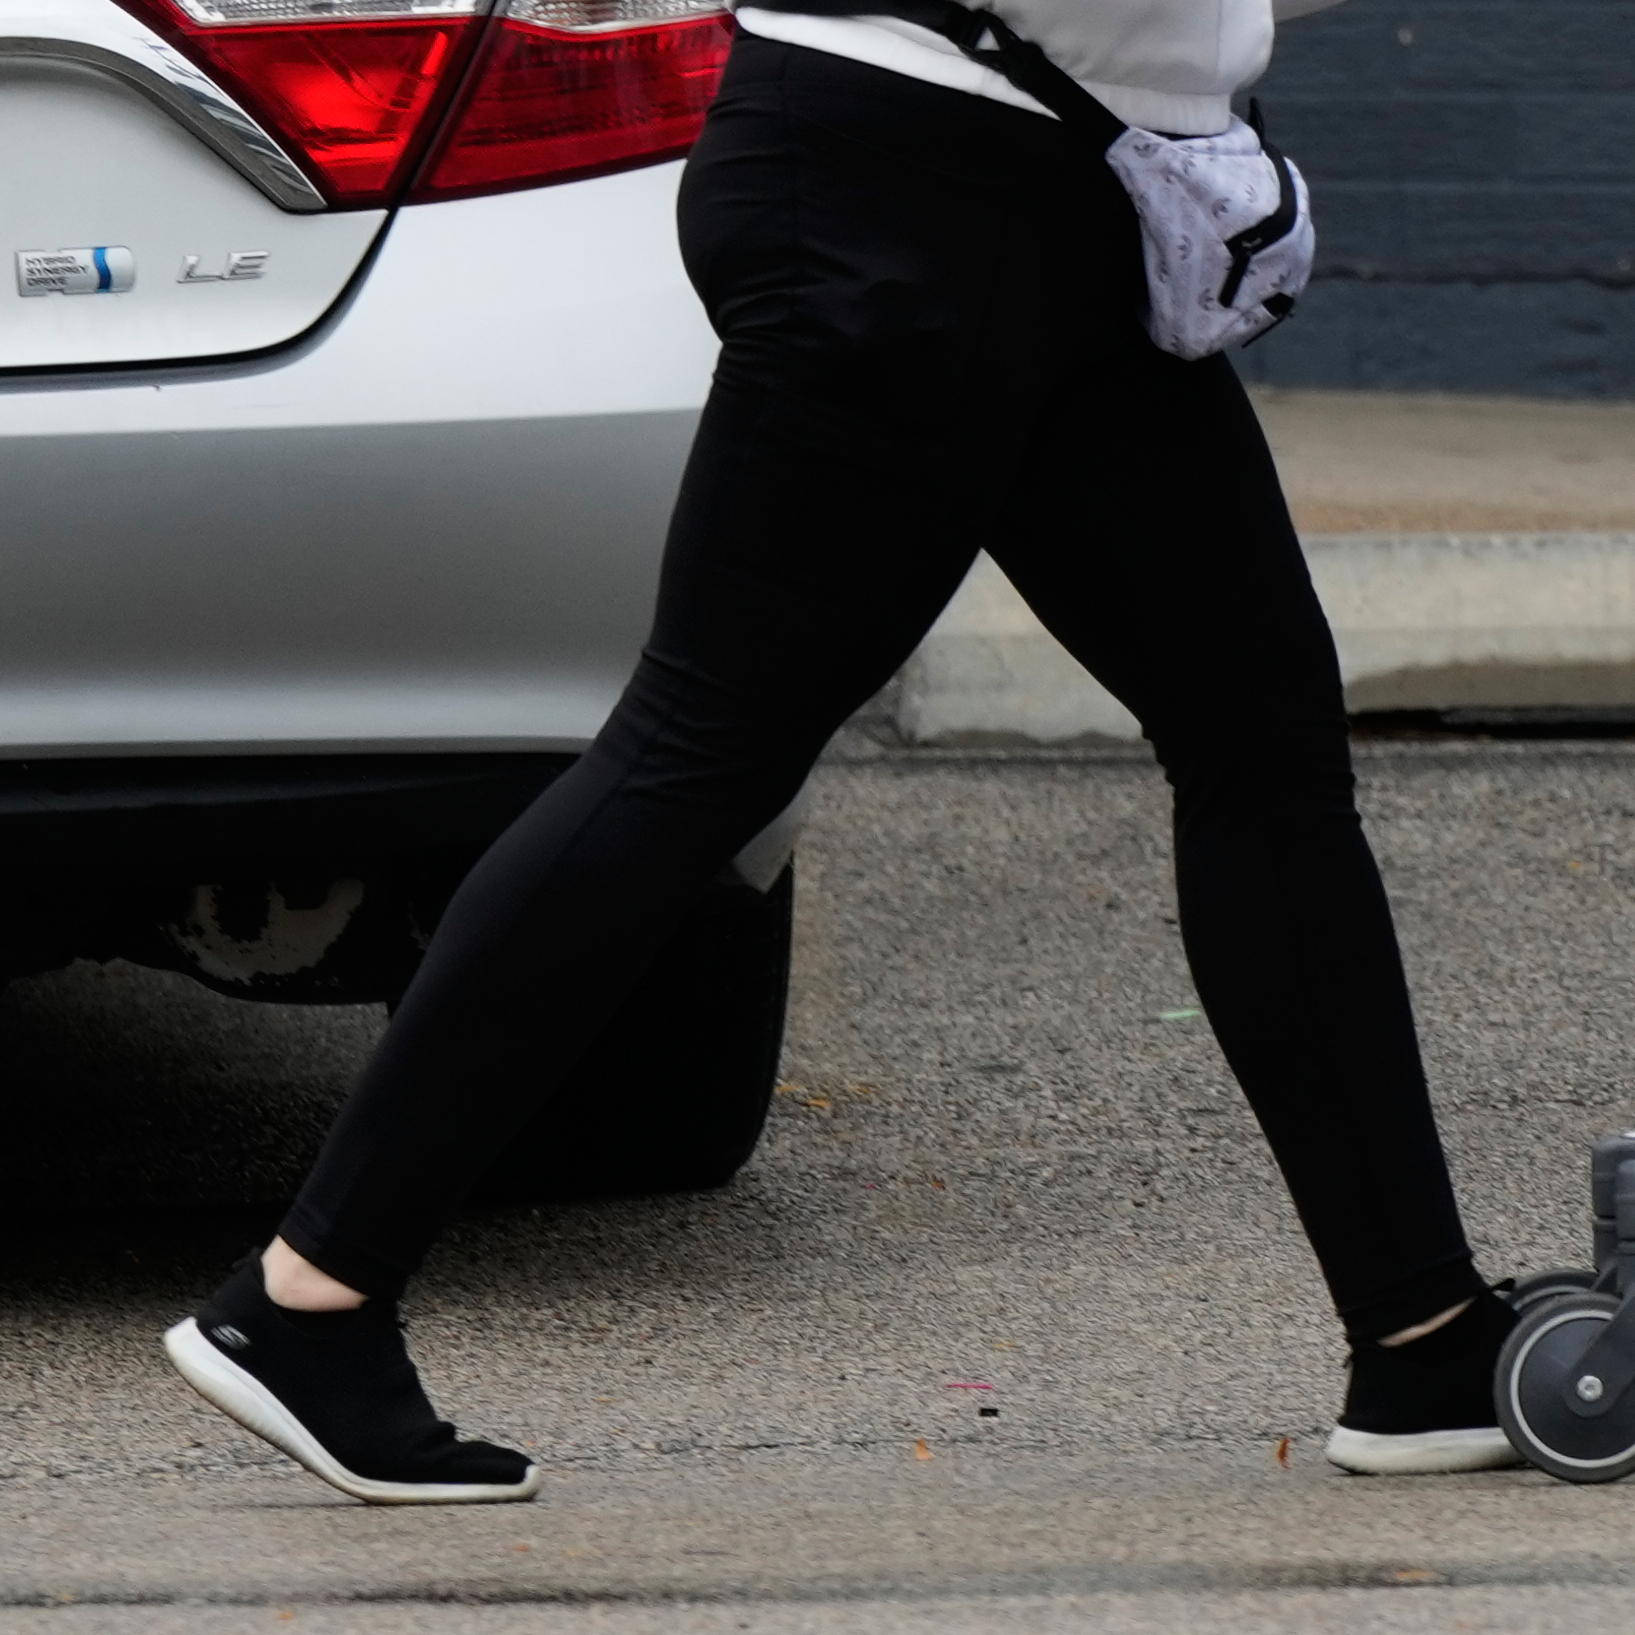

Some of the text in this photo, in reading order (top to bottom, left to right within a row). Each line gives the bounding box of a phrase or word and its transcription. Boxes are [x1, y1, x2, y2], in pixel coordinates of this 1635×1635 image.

[26, 264, 89, 276] SYNERGY
[176, 250, 270, 284] LE
[27, 276, 69, 287] DRIVE
